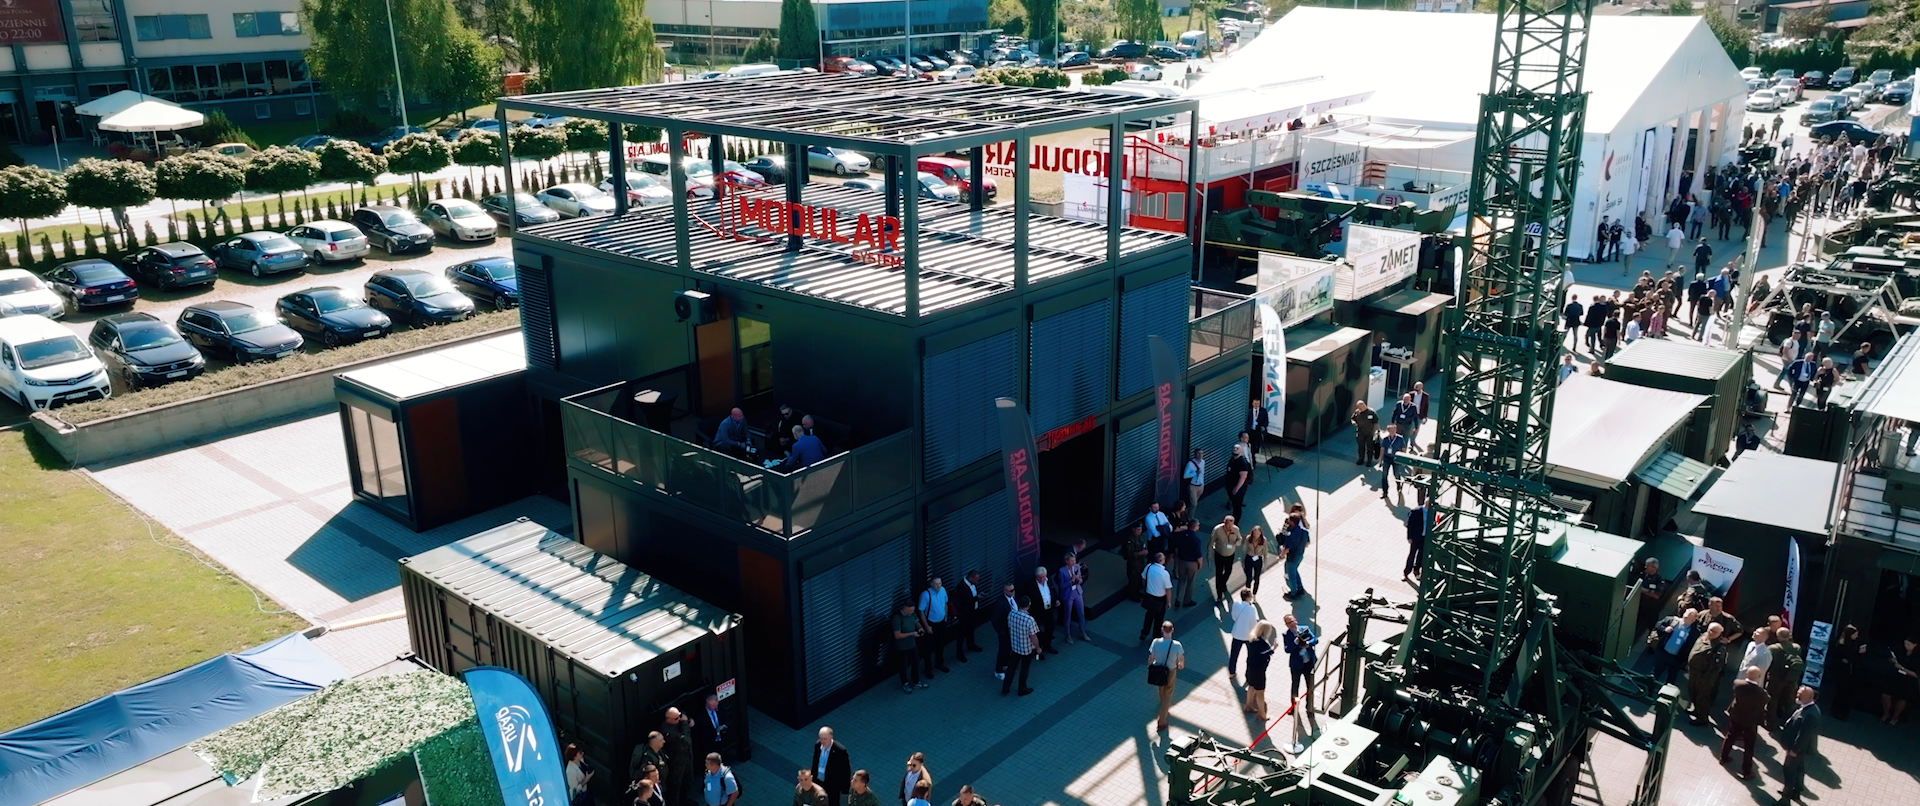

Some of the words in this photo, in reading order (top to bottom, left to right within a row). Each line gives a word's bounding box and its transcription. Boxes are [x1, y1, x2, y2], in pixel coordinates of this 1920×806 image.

[12, 29, 41, 39] 22:00
[739, 195, 900, 251] MODULAR
[852, 250, 903, 268] SYSTEM
[1379, 244, 1417, 275] ZAMET
